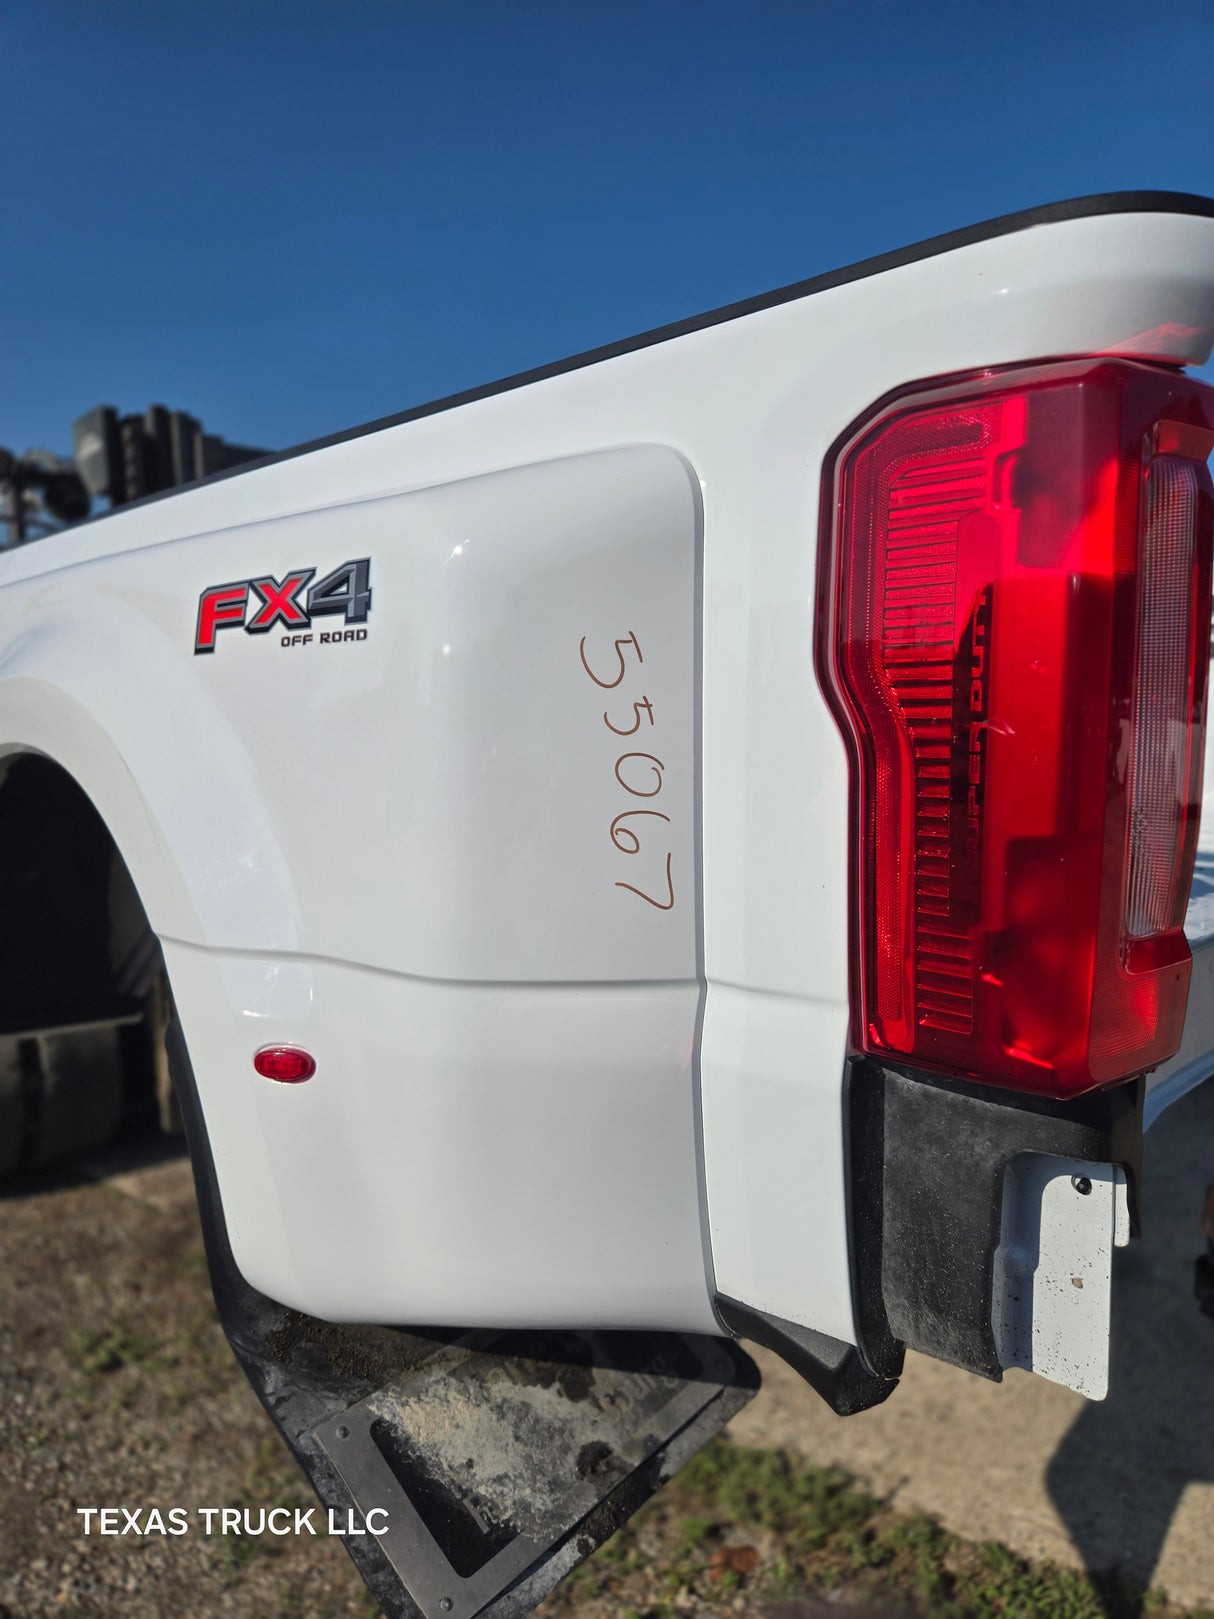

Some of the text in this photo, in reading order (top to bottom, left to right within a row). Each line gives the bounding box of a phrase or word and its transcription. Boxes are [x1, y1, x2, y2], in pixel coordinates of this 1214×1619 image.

[194, 556, 372, 656] FX4
[280, 628, 368, 648] OFF ROAD
[970, 591, 987, 712] DUTY
[580, 630, 674, 910] 55067
